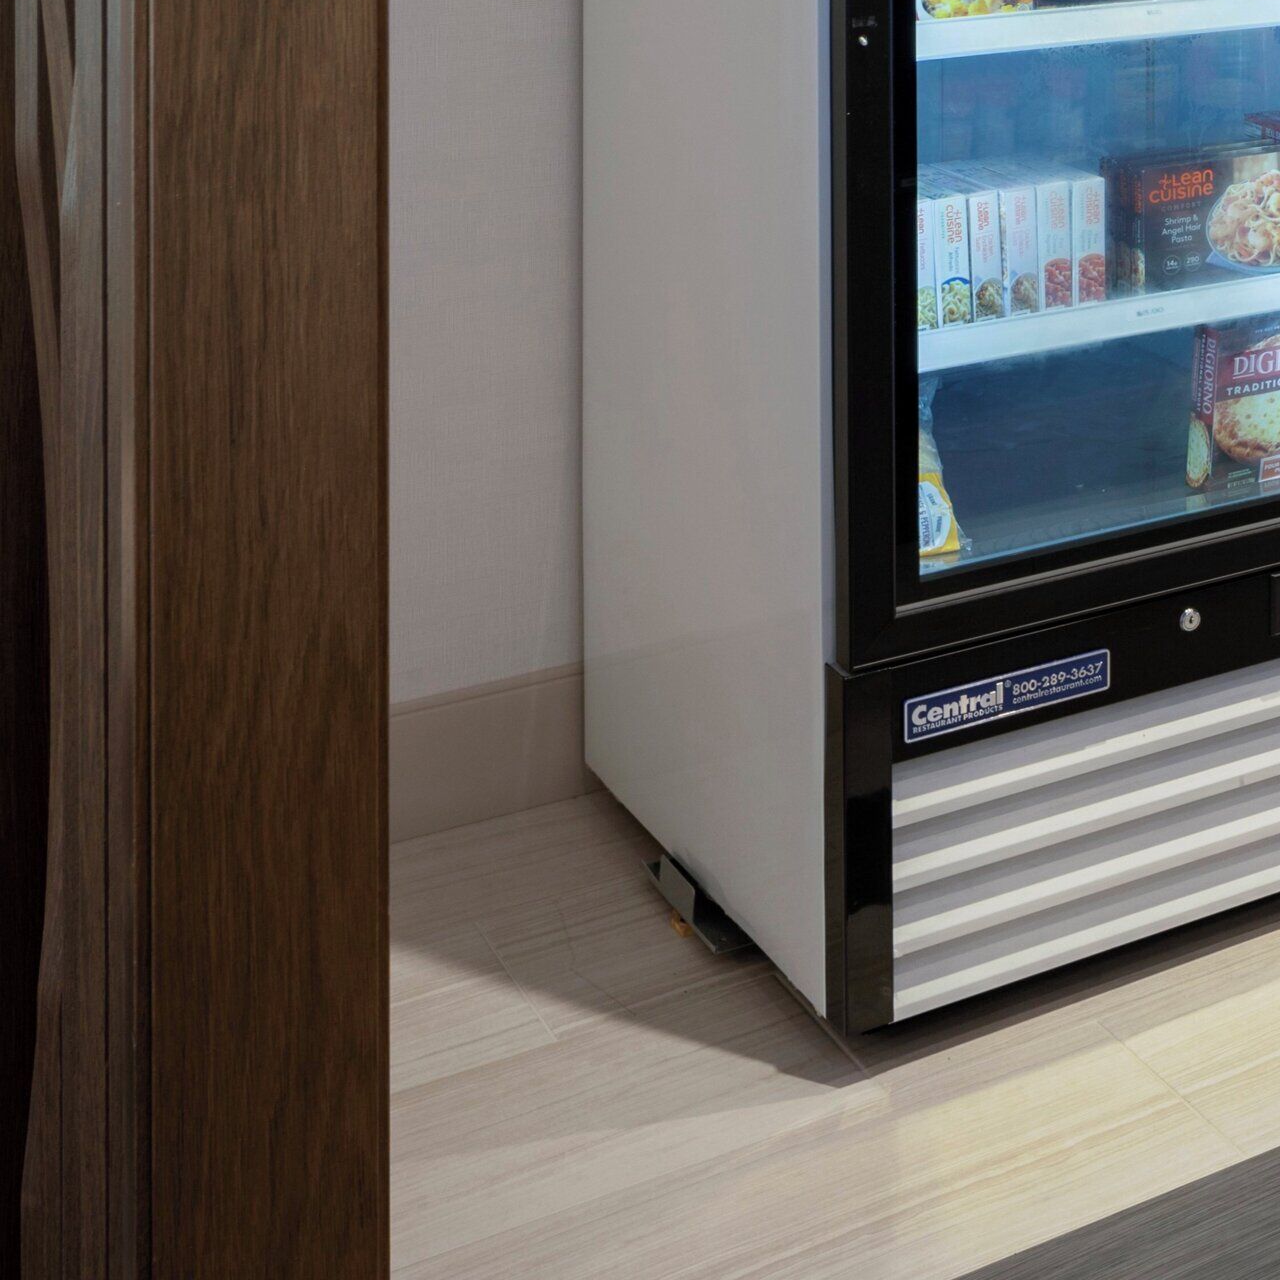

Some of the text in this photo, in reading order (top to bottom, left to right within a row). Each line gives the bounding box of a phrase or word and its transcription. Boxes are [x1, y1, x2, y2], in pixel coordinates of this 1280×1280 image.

[1172, 168, 1214, 187] Lean
[1148, 182, 1214, 204] cuisine
[946, 204, 955, 244] cuisine
[954, 217, 963, 243] Lean
[1161, 223, 1202, 236] Angel Hair
[1165, 216, 1191, 226] Shrimp
[1171, 235, 1193, 244] Pasta
[1012, 661, 1104, 696] 800-289-3637
[1012, 674, 1103, 705] centralrestaurant.com
[911, 681, 1005, 726] Central
[912, 705, 1004, 735] RESTAURANT PRODUCTS
